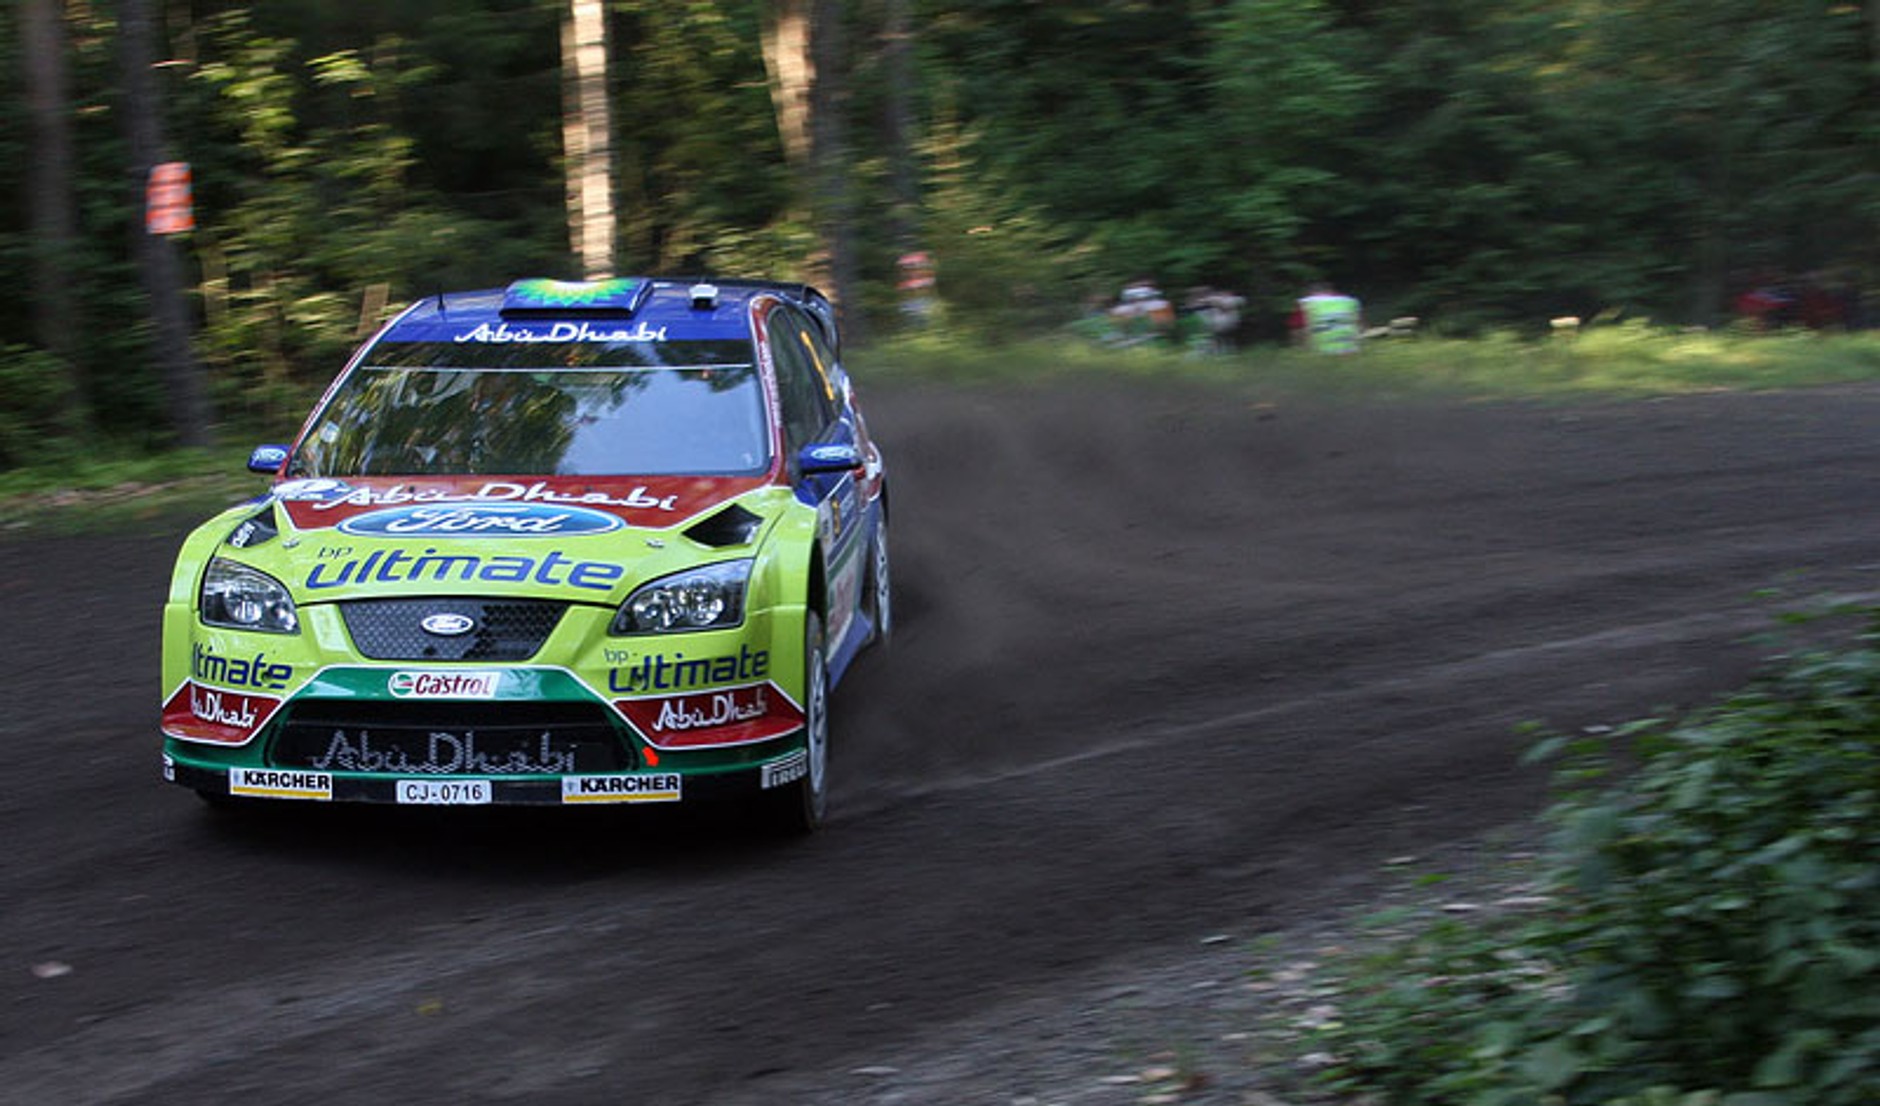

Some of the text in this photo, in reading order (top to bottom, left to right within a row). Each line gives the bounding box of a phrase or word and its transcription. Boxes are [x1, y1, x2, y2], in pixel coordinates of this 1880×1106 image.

[454, 321, 667, 342] Abu Dhabi
[312, 484, 468, 510] Abu
[475, 481, 678, 510] Dhabi
[386, 505, 572, 532] Ford
[306, 549, 624, 590] ultimate
[604, 649, 629, 663] bp
[609, 644, 769, 692] ultimate
[414, 674, 491, 696] Castrol
[206, 691, 258, 728] Dhabi
[652, 700, 710, 731] Abu
[312, 730, 577, 773] Abu Dhabi
[406, 783, 483, 802] CJ-0716
